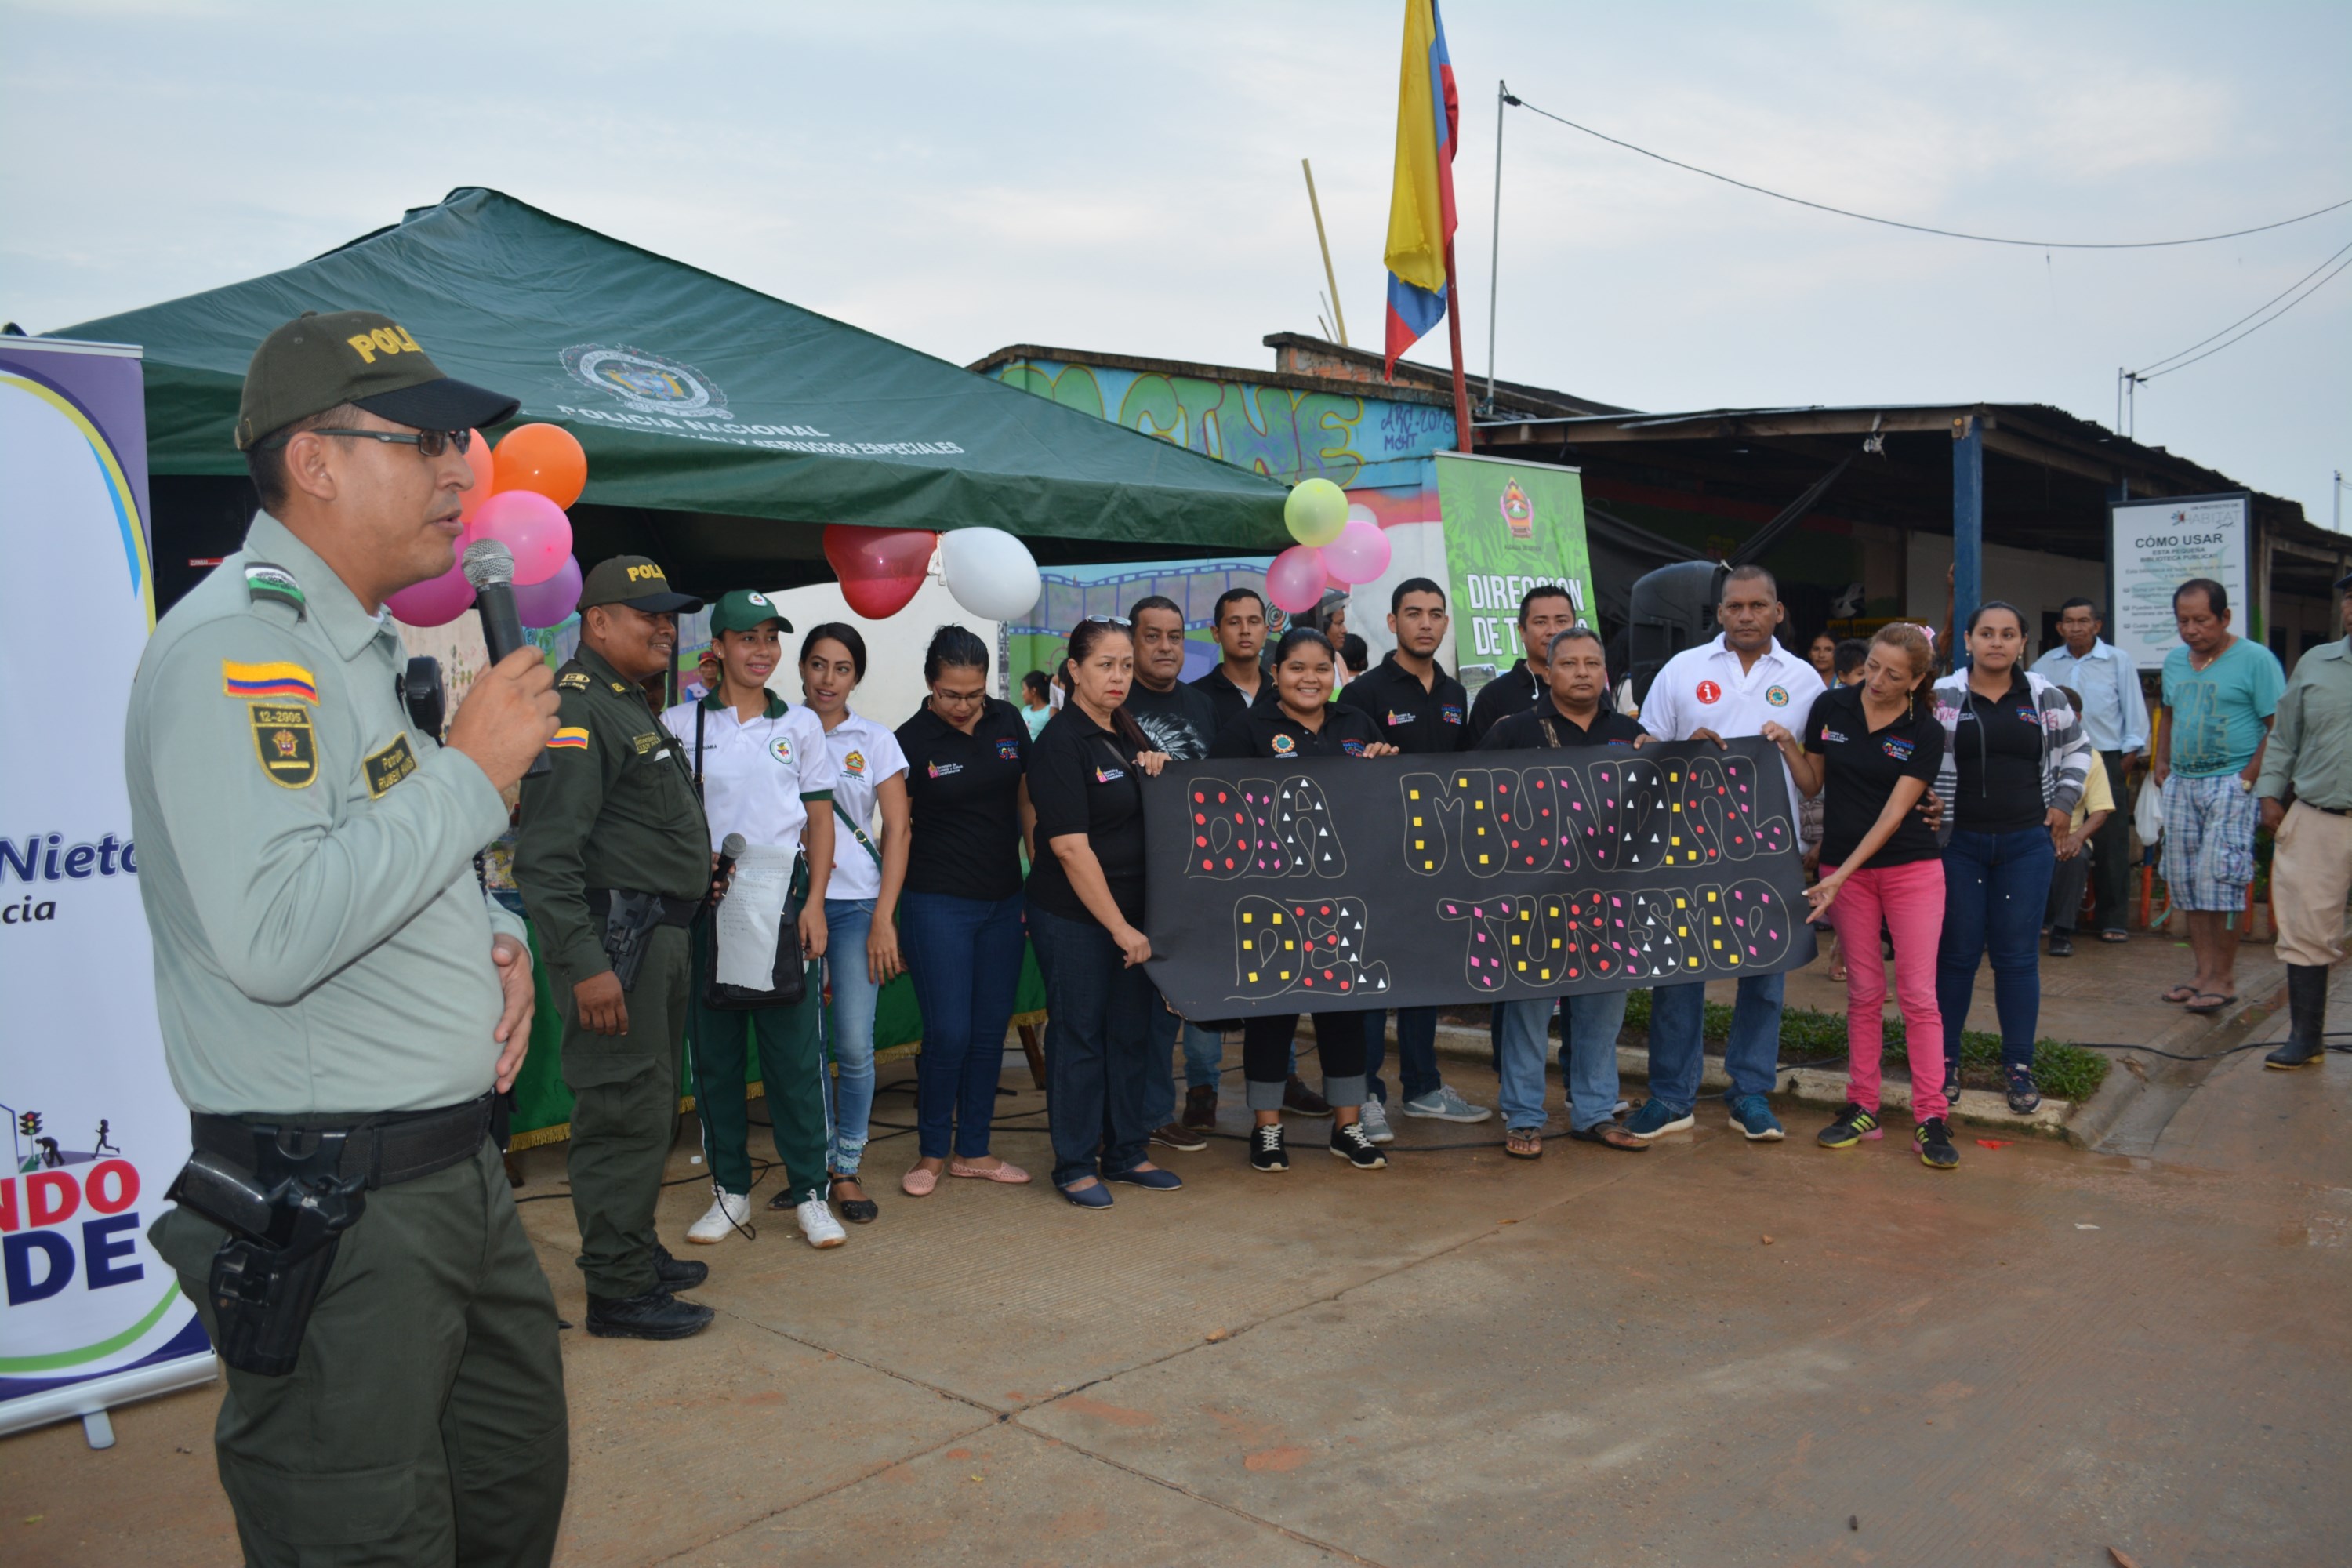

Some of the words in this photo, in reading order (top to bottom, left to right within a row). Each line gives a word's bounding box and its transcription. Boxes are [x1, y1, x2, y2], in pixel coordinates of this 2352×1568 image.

[556, 405, 684, 430] POLICIA
[682, 419, 831, 437] NACIONAL
[752, 440, 858, 454] SERVICIOS
[854, 441, 965, 455] ESPECIALES
[2184, 510, 2241, 525] HABITAT
[2135, 535, 2179, 548] CÓMO
[2183, 533, 2223, 546] USAR
[1472, 617, 1503, 656] DE
[1184, 775, 1347, 881] DIA
[1400, 756, 1793, 878] MUNDIAL
[1223, 895, 1391, 1002] DEL
[1437, 878, 1791, 992] TURISMO
